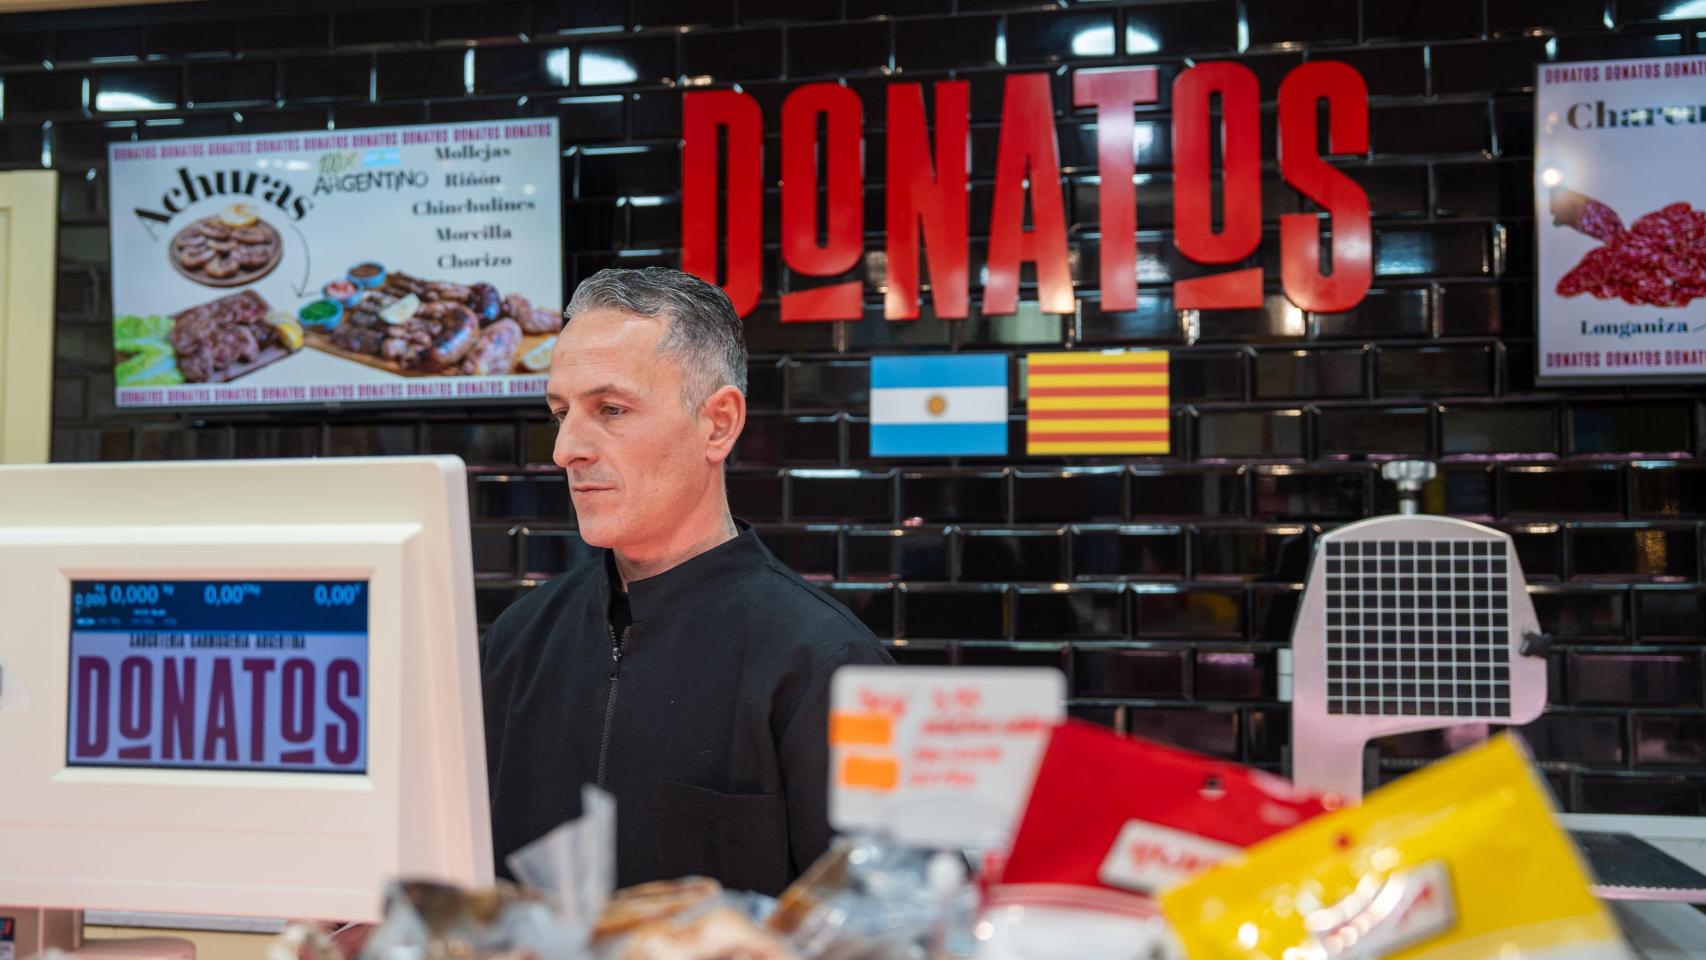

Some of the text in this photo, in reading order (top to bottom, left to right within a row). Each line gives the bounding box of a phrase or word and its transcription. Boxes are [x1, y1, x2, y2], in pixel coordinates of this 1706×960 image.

[1545, 61, 1706, 84] DONATOS DONATOS DONAT
[435, 144, 511, 161] Mollejas
[313, 169, 429, 196] ARGENTINO
[445, 172, 501, 187] Riñón
[682, 61, 1372, 321] DONATOS
[133, 166, 314, 241] Achuras
[412, 198, 536, 216] Chinchulines
[436, 226, 512, 242] Morcilla
[437, 252, 512, 269] Chorizo
[1581, 318, 1688, 339] Longaniza
[1665, 350, 1706, 366] DONAT
[110, 584, 159, 607] 0,000
[75, 655, 361, 765] DONATOS
